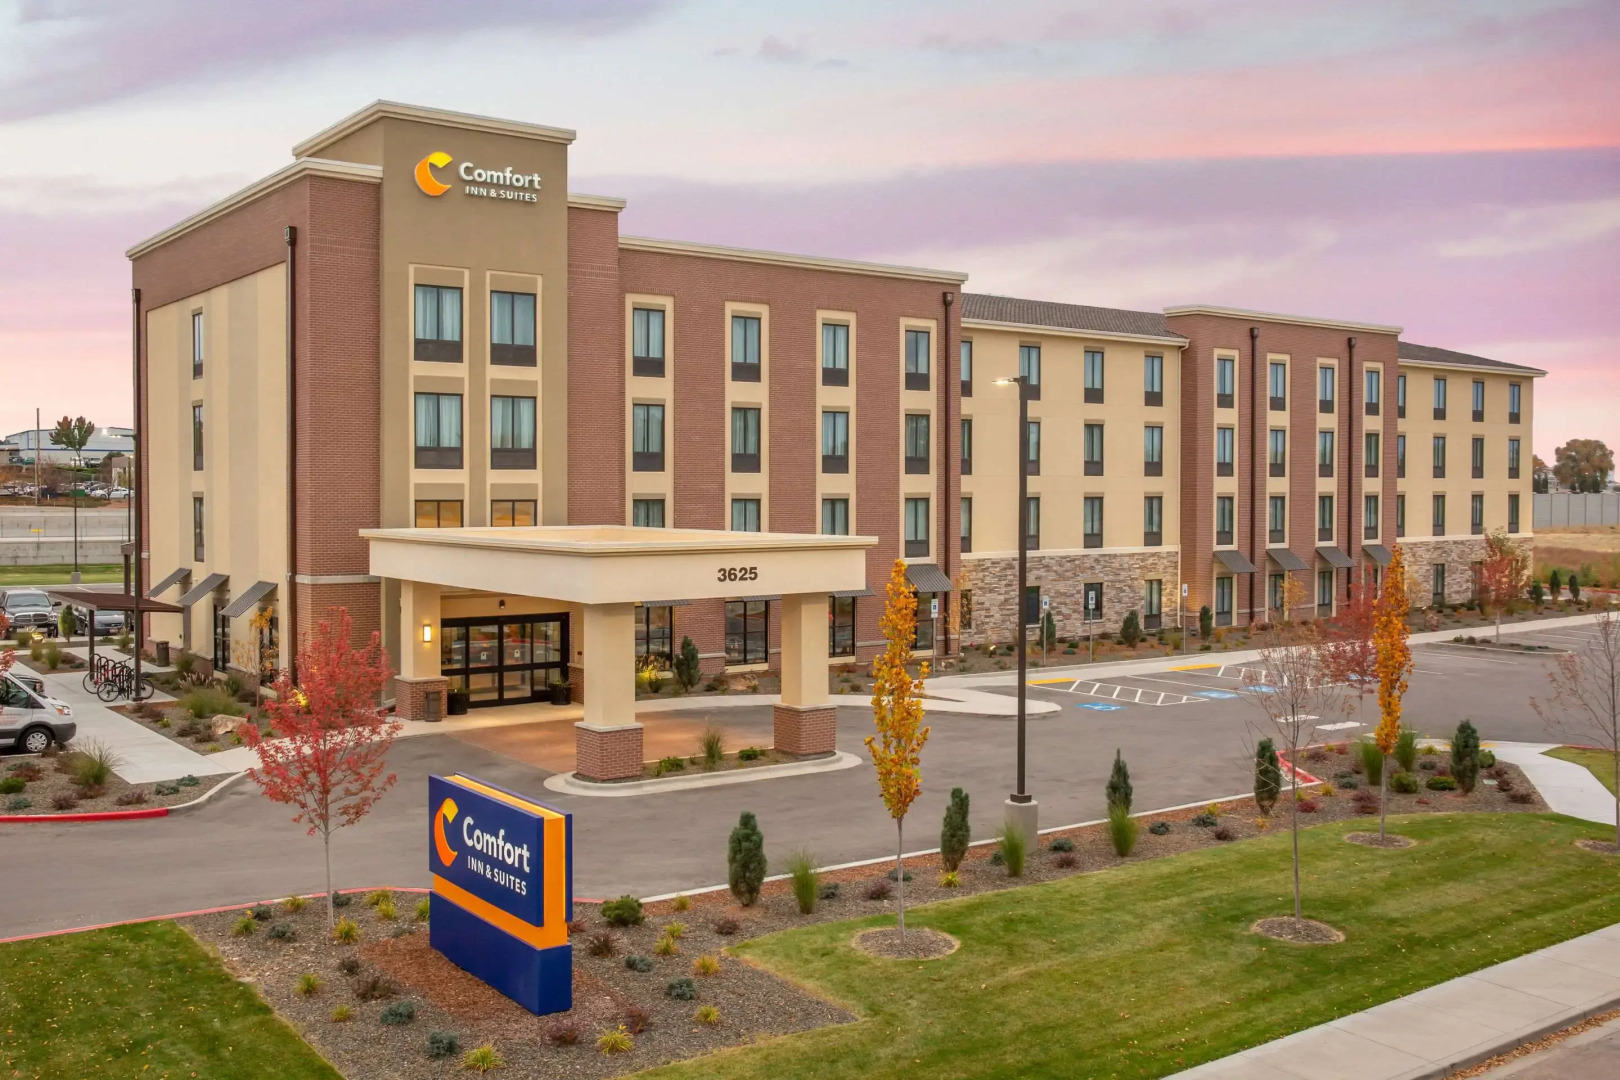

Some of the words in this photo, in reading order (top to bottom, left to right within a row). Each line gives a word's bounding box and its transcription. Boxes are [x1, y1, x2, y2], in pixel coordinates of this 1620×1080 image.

[458, 162, 541, 190] Comfort
[465, 185, 487, 197] INN
[489, 188, 497, 198] &
[499, 189, 538, 203] SUITES
[717, 566, 758, 583] 3625
[462, 816, 530, 874] Comfort
[467, 855, 484, 876] INN
[485, 863, 492, 880] &
[493, 867, 527, 896] SUITES
